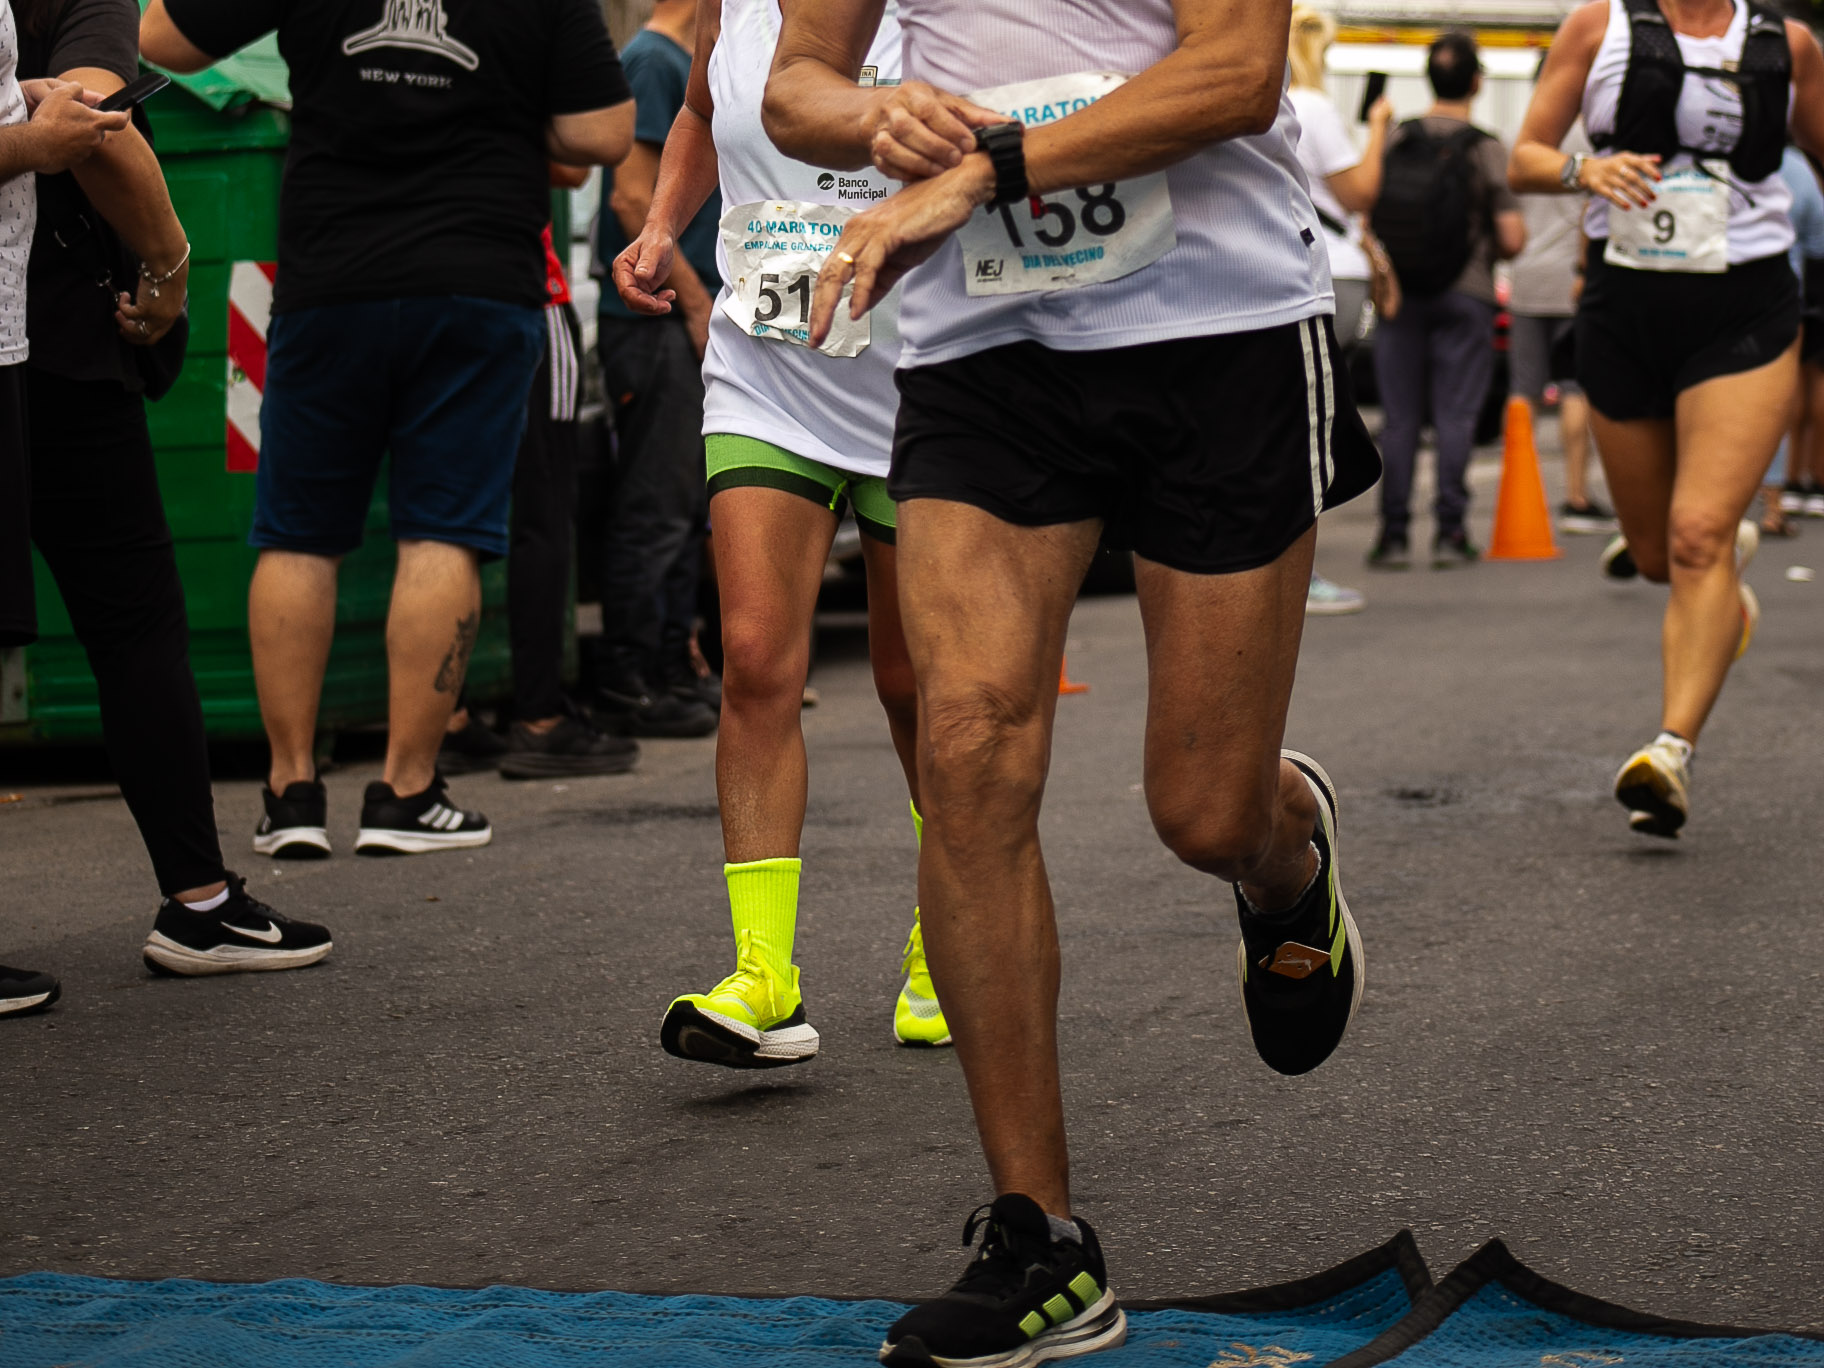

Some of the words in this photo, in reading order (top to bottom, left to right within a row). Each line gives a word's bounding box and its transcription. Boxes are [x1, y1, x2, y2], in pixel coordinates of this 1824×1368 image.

[360, 68, 399, 83] NEW
[404, 72, 452, 88] YORK
[1000, 95, 1104, 124] ARATO
[838, 177, 868, 188] Banco
[838, 187, 887, 201] Municipal
[985, 183, 1126, 248] 158
[747, 220, 763, 234] 40
[765, 220, 844, 237] MARATON
[1653, 209, 1675, 244] 9
[790, 242, 834, 252] GRANER
[1022, 254, 1041, 269] DIA
[1061, 246, 1105, 267] VECINO
[975, 259, 1004, 277] NEJ
[754, 273, 810, 324] 51
[754, 324, 770, 336] DIA
[782, 328, 811, 341] VECIN
